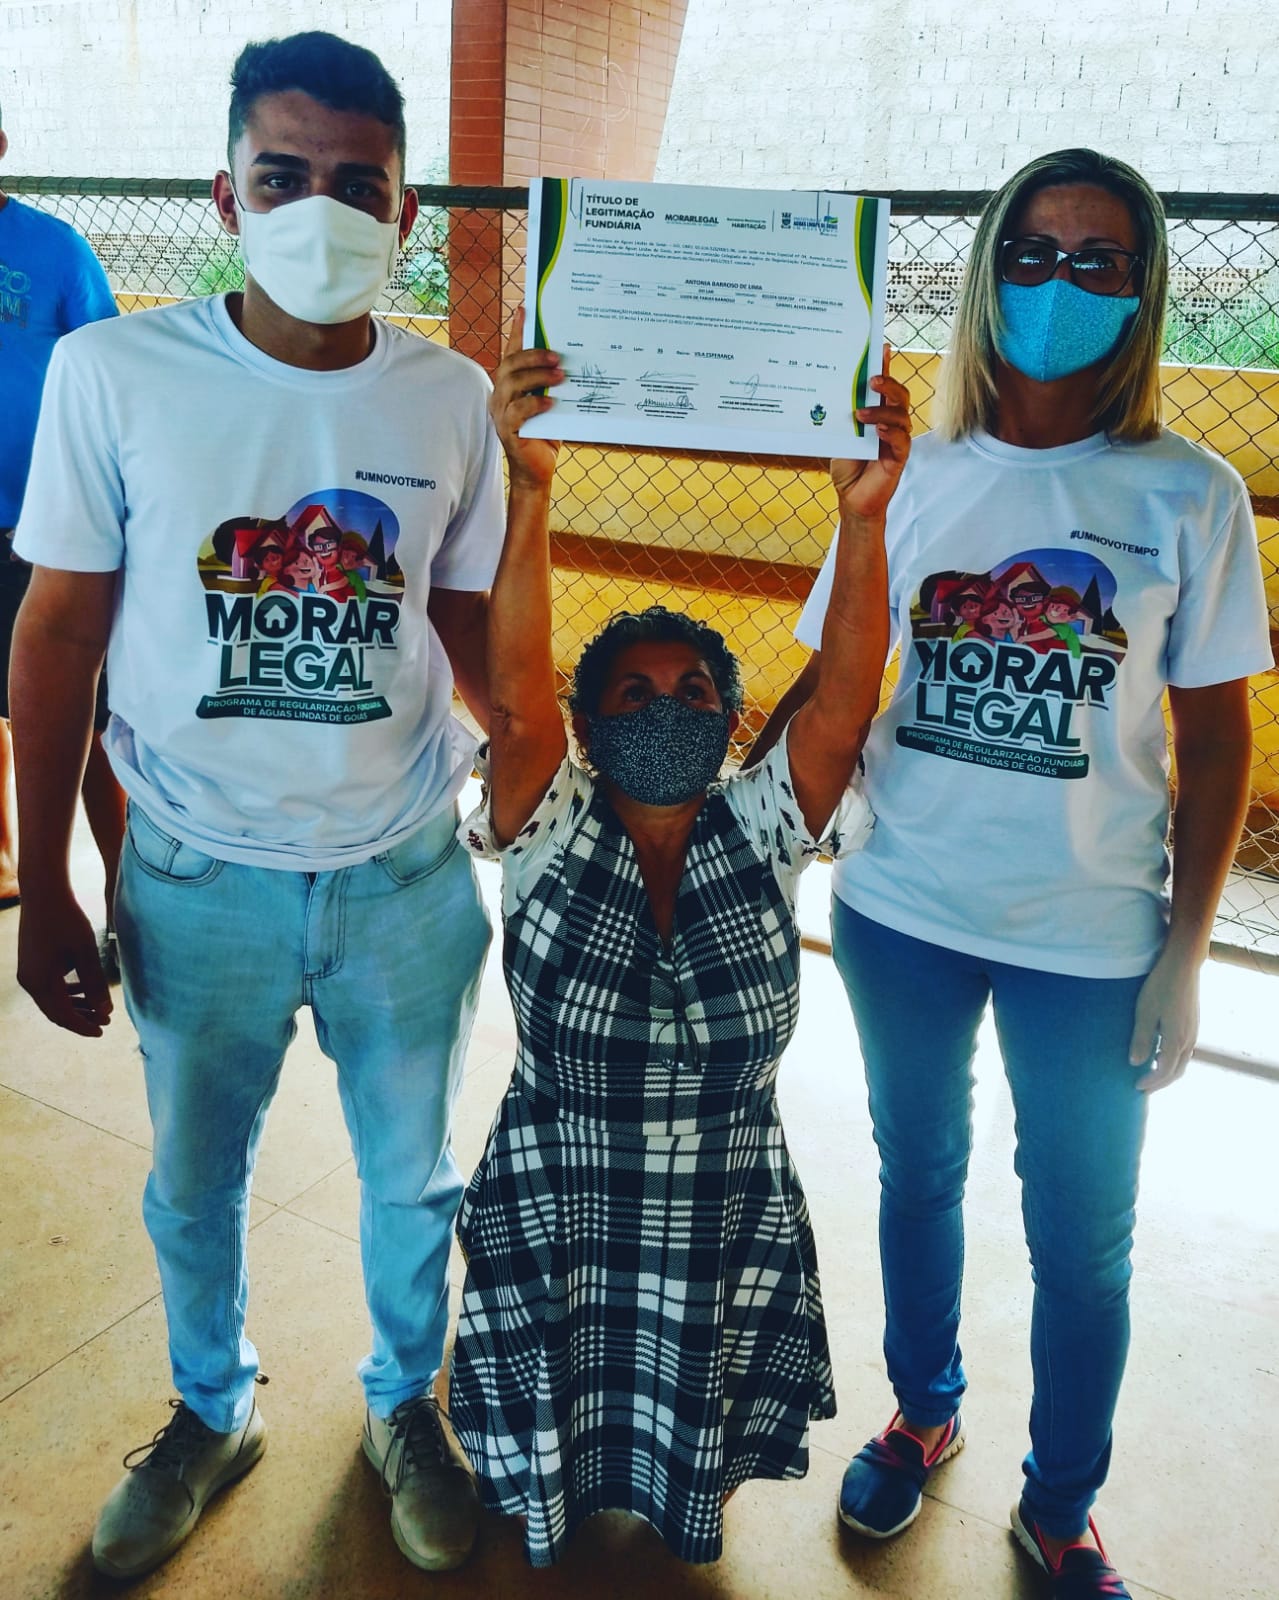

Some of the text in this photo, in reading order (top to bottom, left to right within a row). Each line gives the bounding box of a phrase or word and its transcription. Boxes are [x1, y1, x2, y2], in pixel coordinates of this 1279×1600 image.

[586, 193, 639, 206] TÍTULO DE
[585, 207, 655, 220] LEGITIMAÇÃO
[585, 219, 642, 231] FUNDIÁRIA
[355, 470, 437, 490] #UMNOVOTEMPO
[1070, 530, 1160, 557] #UMNOVOTEMPO
[205, 593, 400, 645] MORAR
[219, 642, 373, 692] LEGAL
[914, 640, 1116, 703] MORAR
[207, 698, 262, 708] PROGRAMA
[264, 699, 278, 708] DE
[280, 700, 356, 713] REGULARIZAÇÃO
[243, 707, 257, 716] DE
[294, 711, 327, 721] LINDAS
[329, 713, 342, 722] DE
[916, 681, 1081, 747] LEGAL
[907, 730, 951, 746] PROGRAMA
[952, 740, 962, 749] DE
[963, 743, 1041, 764] REGULARIZAÇÃO
[935, 745, 944, 754] DE
[975, 754, 1009, 768] LINDAS
[1011, 761, 1025, 770] DE
